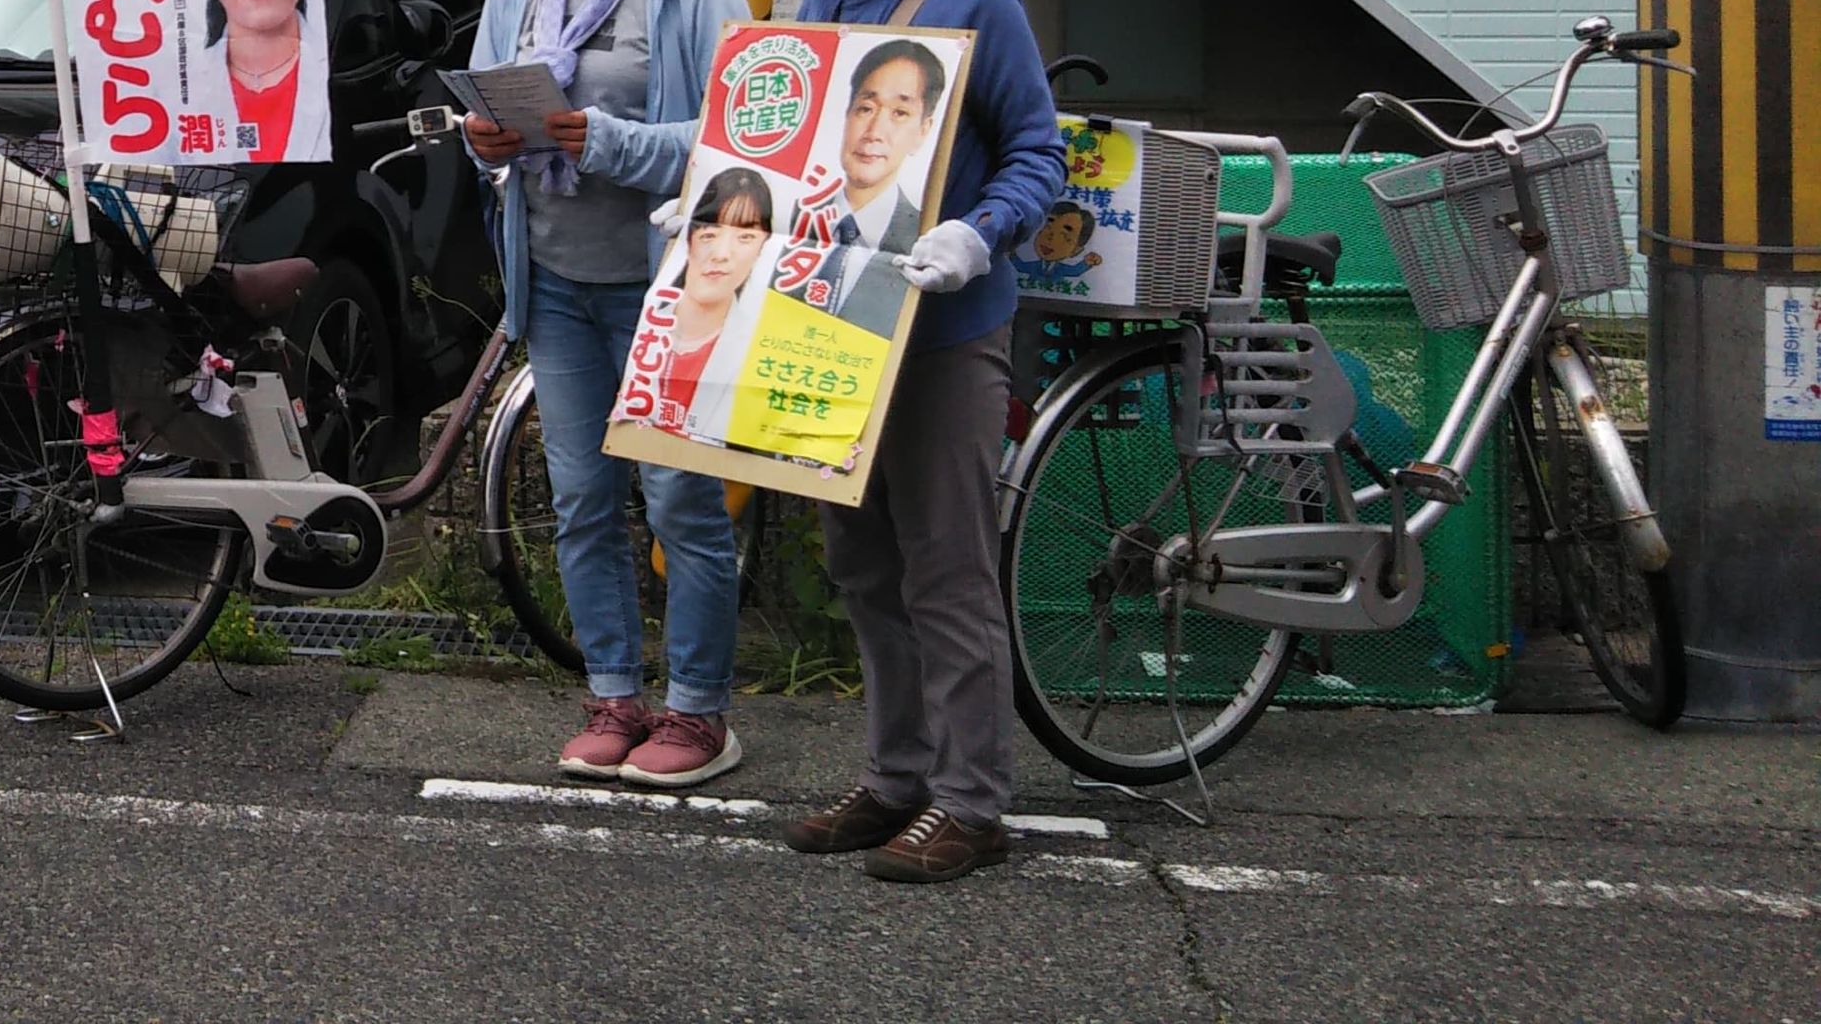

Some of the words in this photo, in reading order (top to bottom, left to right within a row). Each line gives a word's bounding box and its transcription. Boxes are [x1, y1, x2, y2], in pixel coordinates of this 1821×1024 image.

[748, 71, 789, 103] 日本
[178, 114, 215, 154] 潤
[215, 117, 227, 148] じゅん
[733, 99, 799, 136] 共産党
[776, 163, 844, 290] シバタ
[625, 289, 681, 417] こむら
[759, 335, 873, 369] とりのこさない政治で
[756, 356, 859, 396] ささえ合う
[767, 387, 831, 421] 社会を
